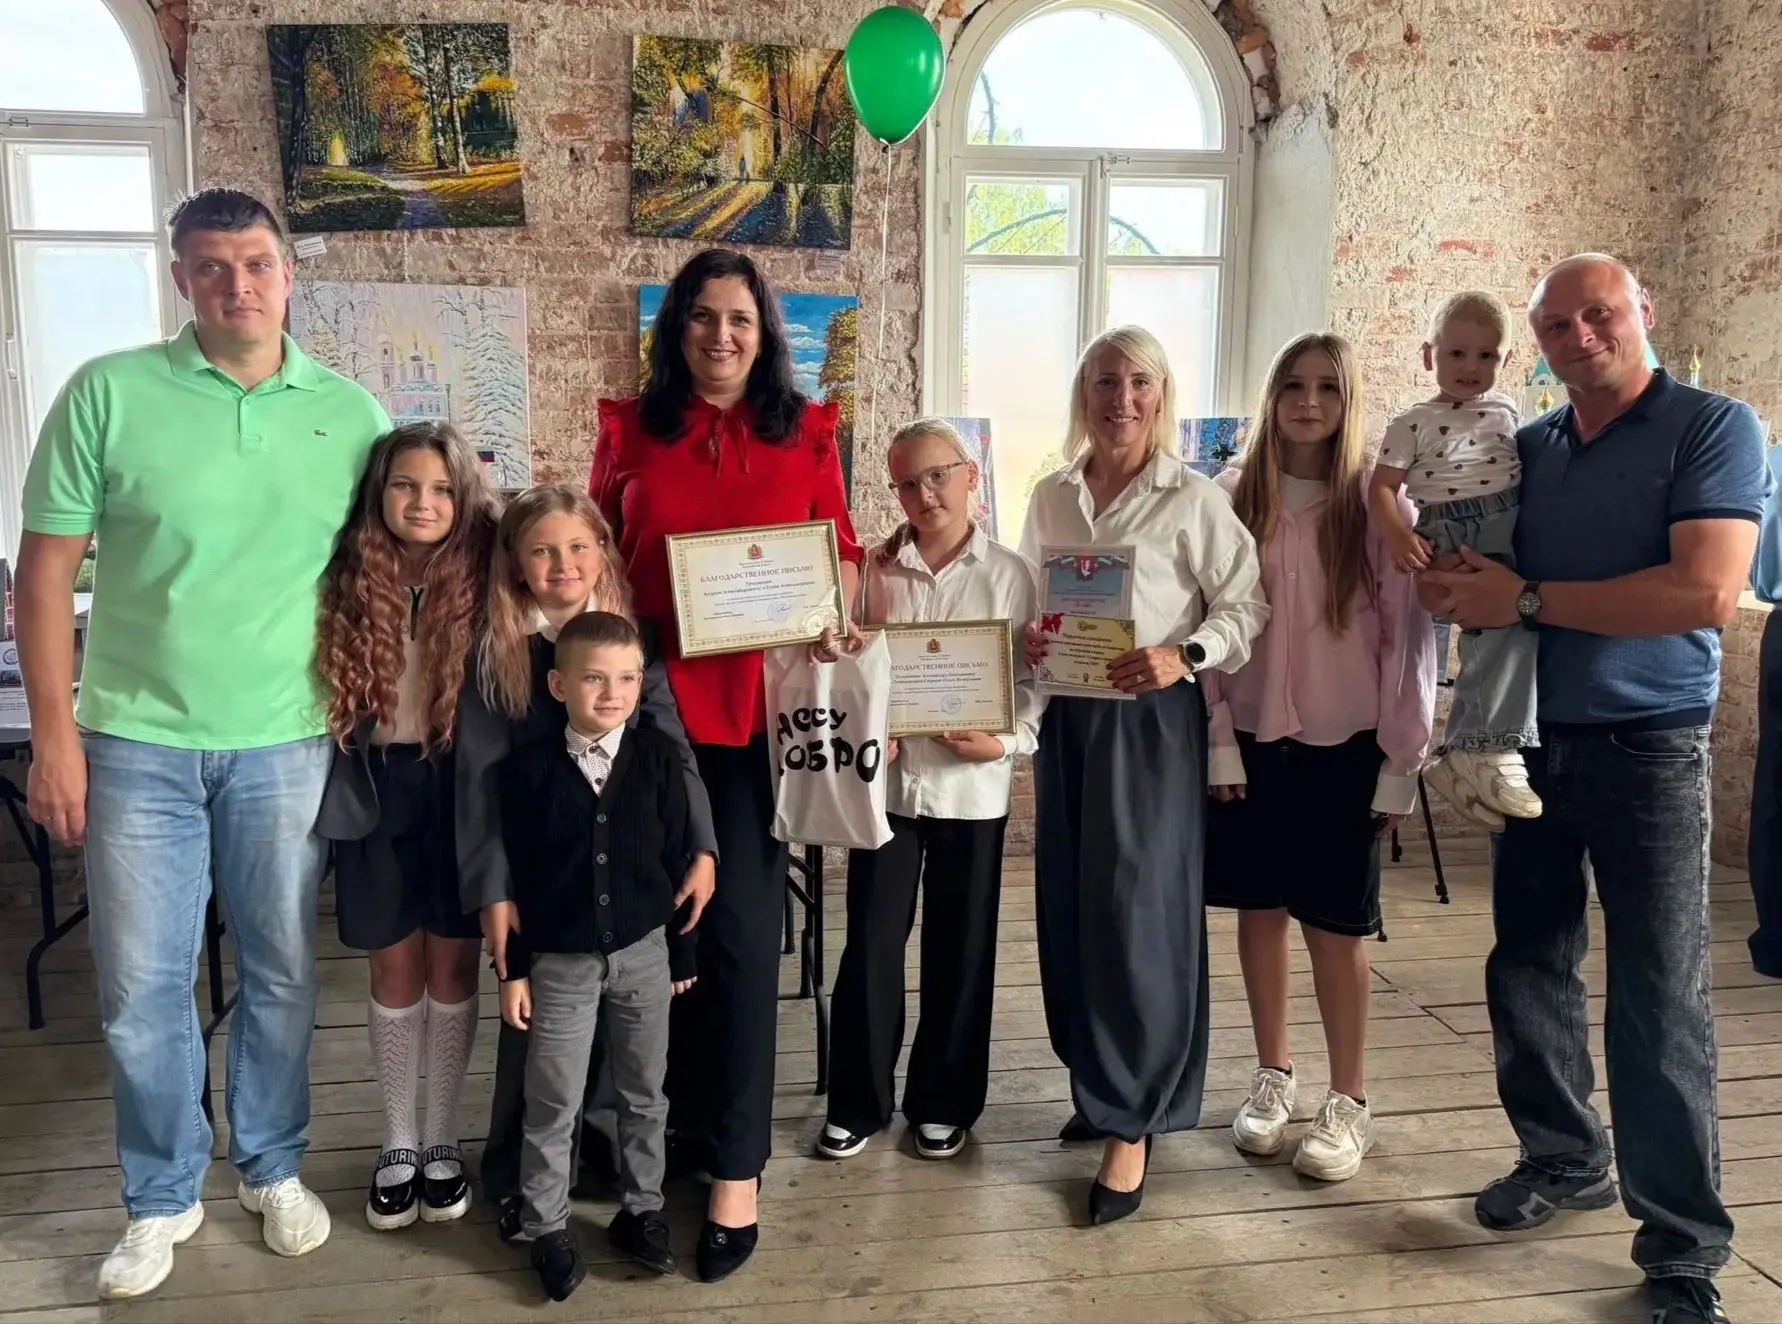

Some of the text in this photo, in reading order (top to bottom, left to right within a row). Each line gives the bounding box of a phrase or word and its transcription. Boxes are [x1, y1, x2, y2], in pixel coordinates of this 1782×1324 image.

[700, 568, 780, 583] БЛАГОДАРСТВЕННОЕ
[781, 565, 814, 575] ПИСЬМО
[891, 662, 956, 672] АГОДАРСТВЕННОЕ
[778, 736, 881, 783] ОБРО
[376, 1150, 418, 1169] UTURIN
